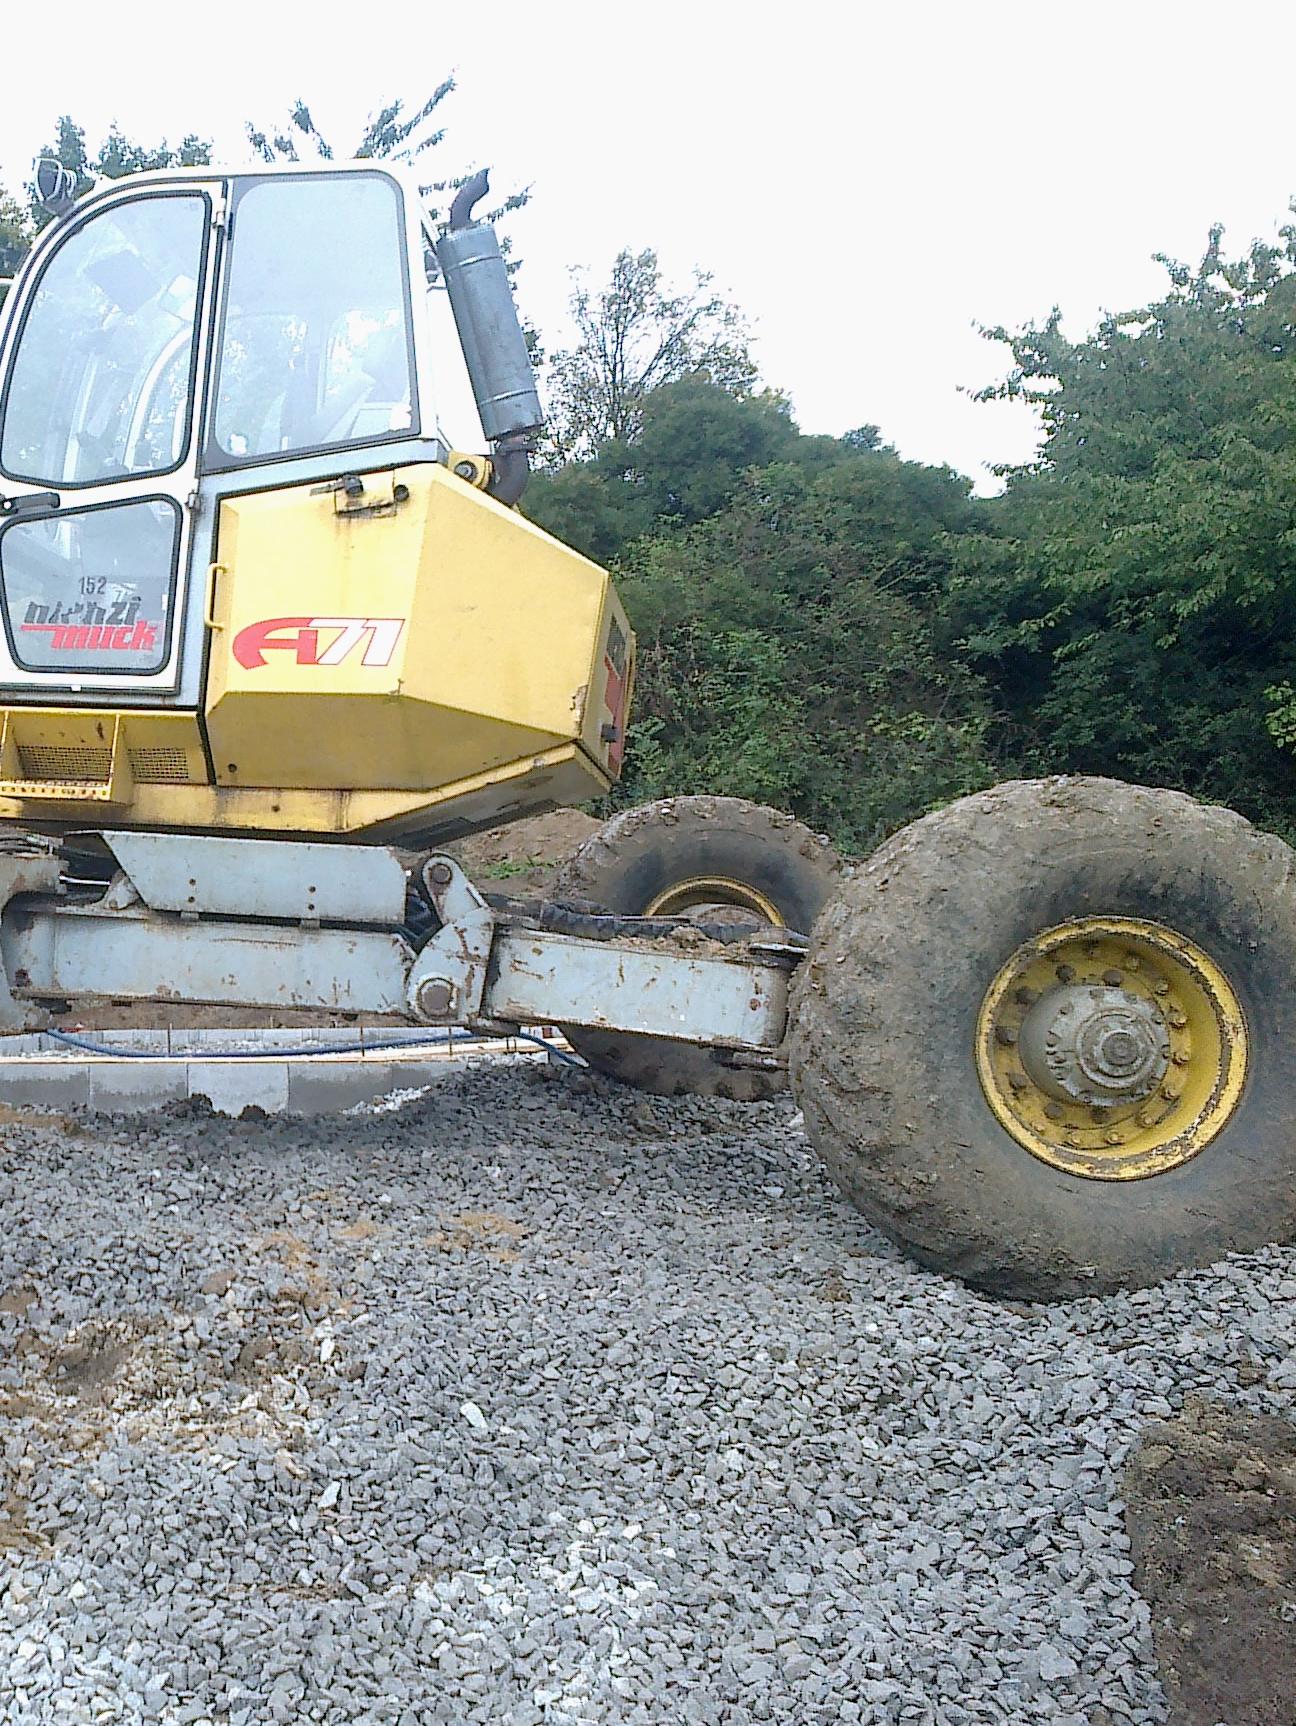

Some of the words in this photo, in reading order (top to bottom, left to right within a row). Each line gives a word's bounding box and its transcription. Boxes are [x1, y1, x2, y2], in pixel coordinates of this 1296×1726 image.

[79, 576, 107, 595] 152
[21, 620, 158, 650] muck
[232, 616, 406, 670] A71
